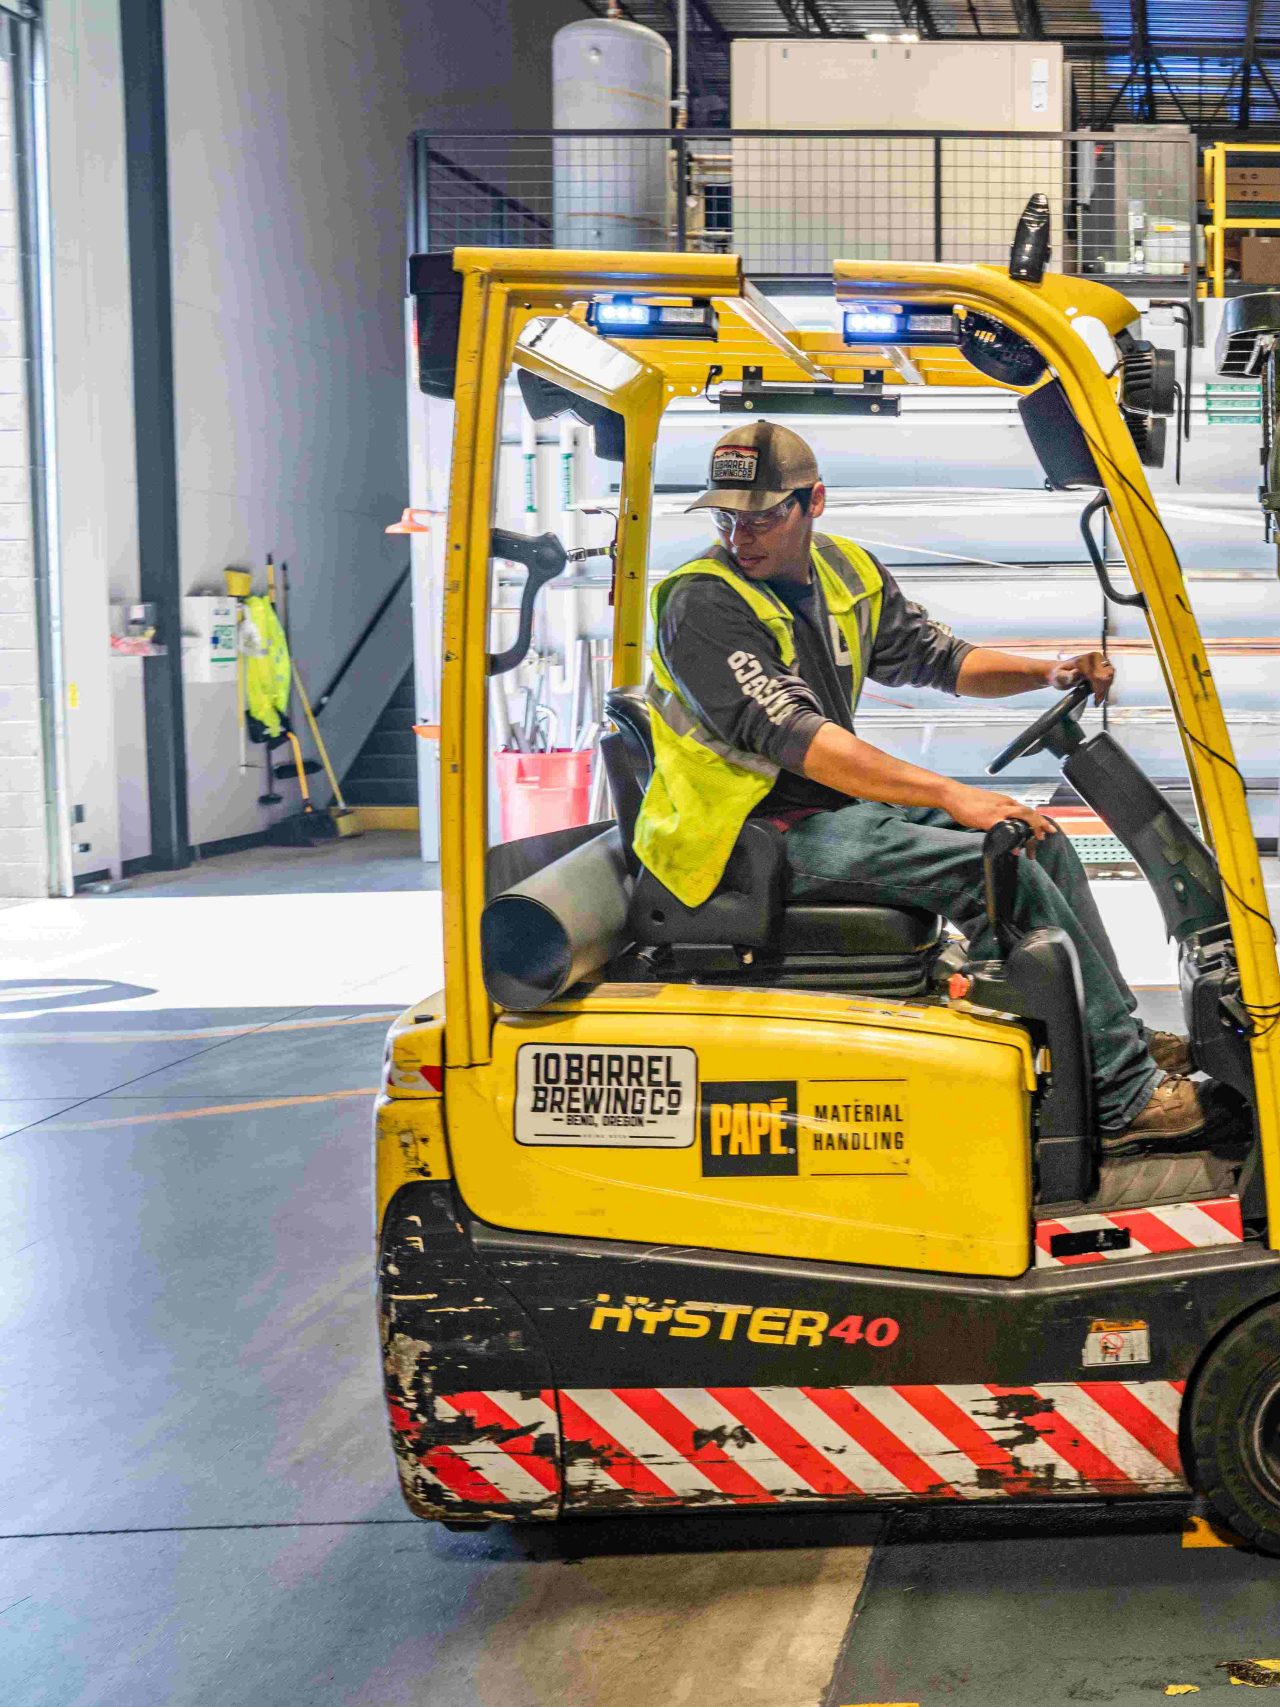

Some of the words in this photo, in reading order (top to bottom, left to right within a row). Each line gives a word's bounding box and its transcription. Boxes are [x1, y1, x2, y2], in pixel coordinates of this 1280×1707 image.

[566, 1115, 599, 1128] BEND,
[602, 1116, 645, 1127] OREGON
[813, 1104, 904, 1124] MATERIAL
[813, 1131, 905, 1151] HANDLING
[590, 1293, 830, 1347] HYSTER
[828, 1315, 900, 1347] 40
